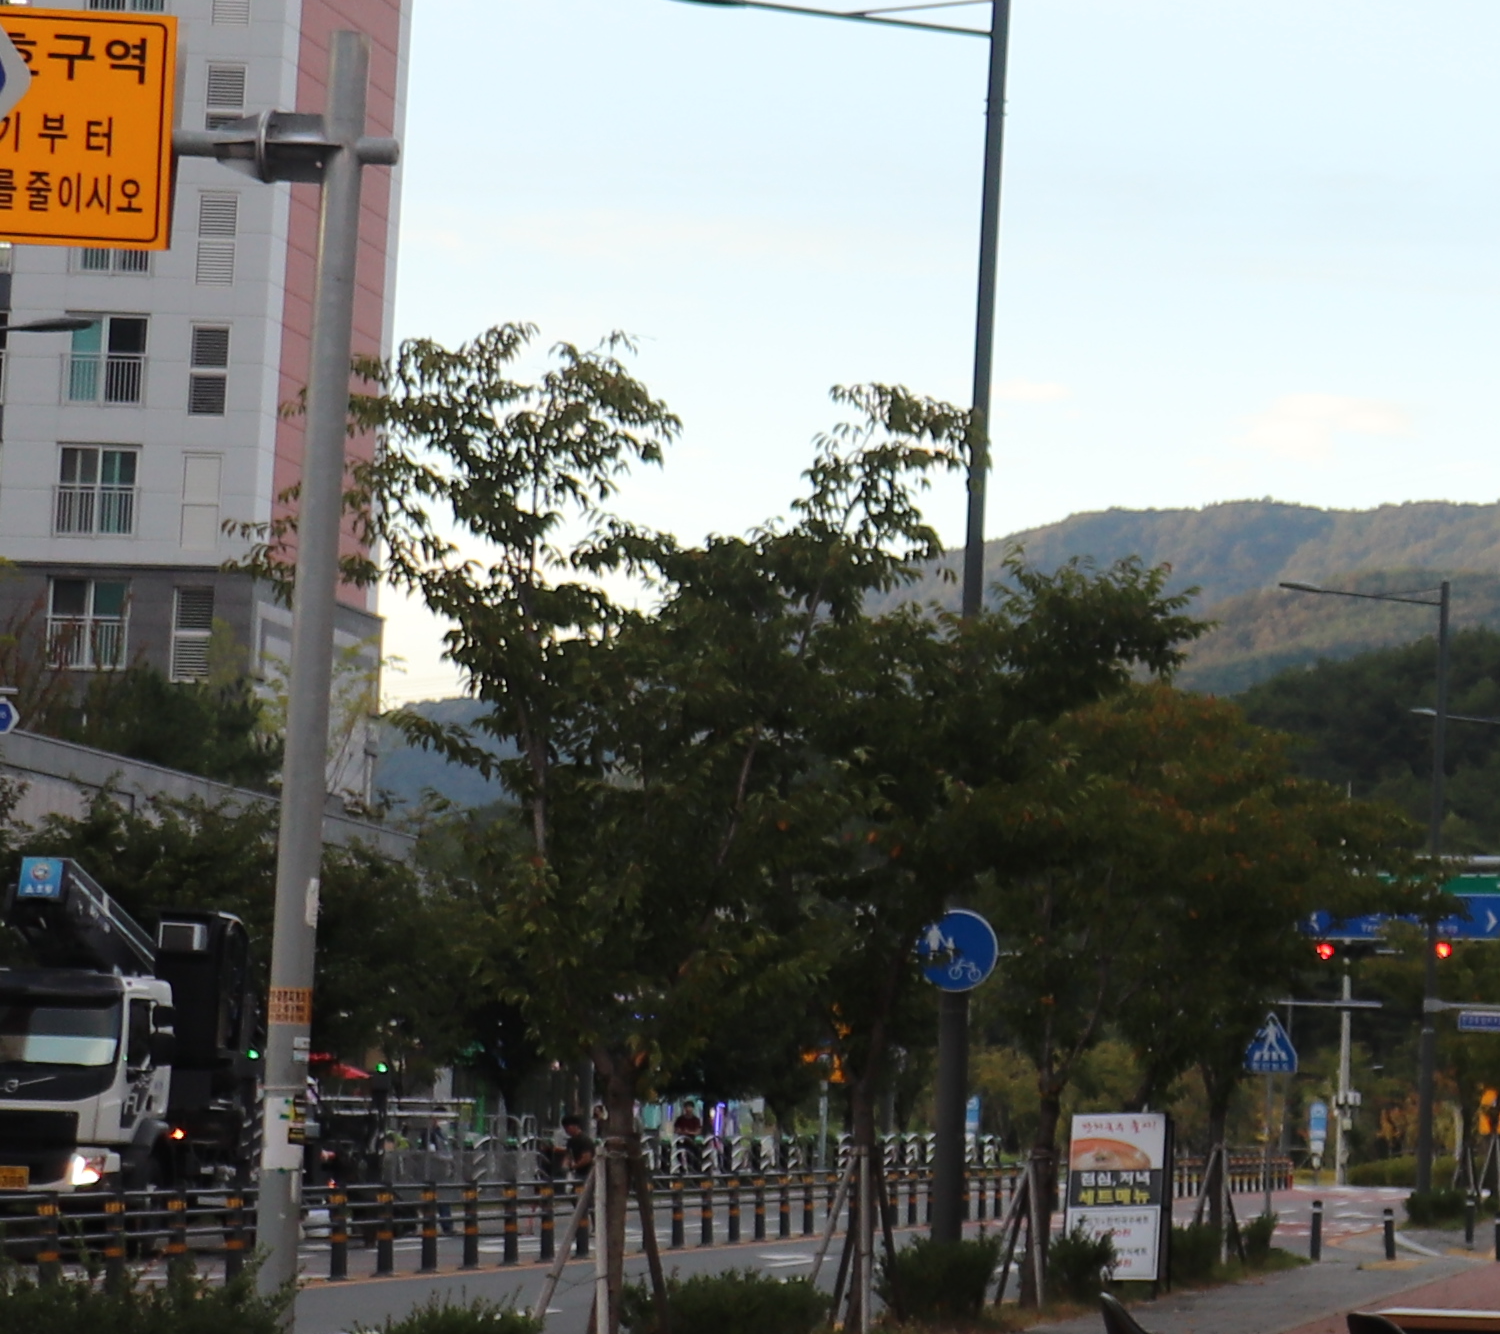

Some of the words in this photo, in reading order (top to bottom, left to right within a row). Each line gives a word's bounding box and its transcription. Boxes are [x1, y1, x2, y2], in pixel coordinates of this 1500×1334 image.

[25, 172, 143, 216] 줄이시오
[1120, 1170, 1151, 1186] 저녁
[1078, 1187, 1151, 1206] 세트메뉴
